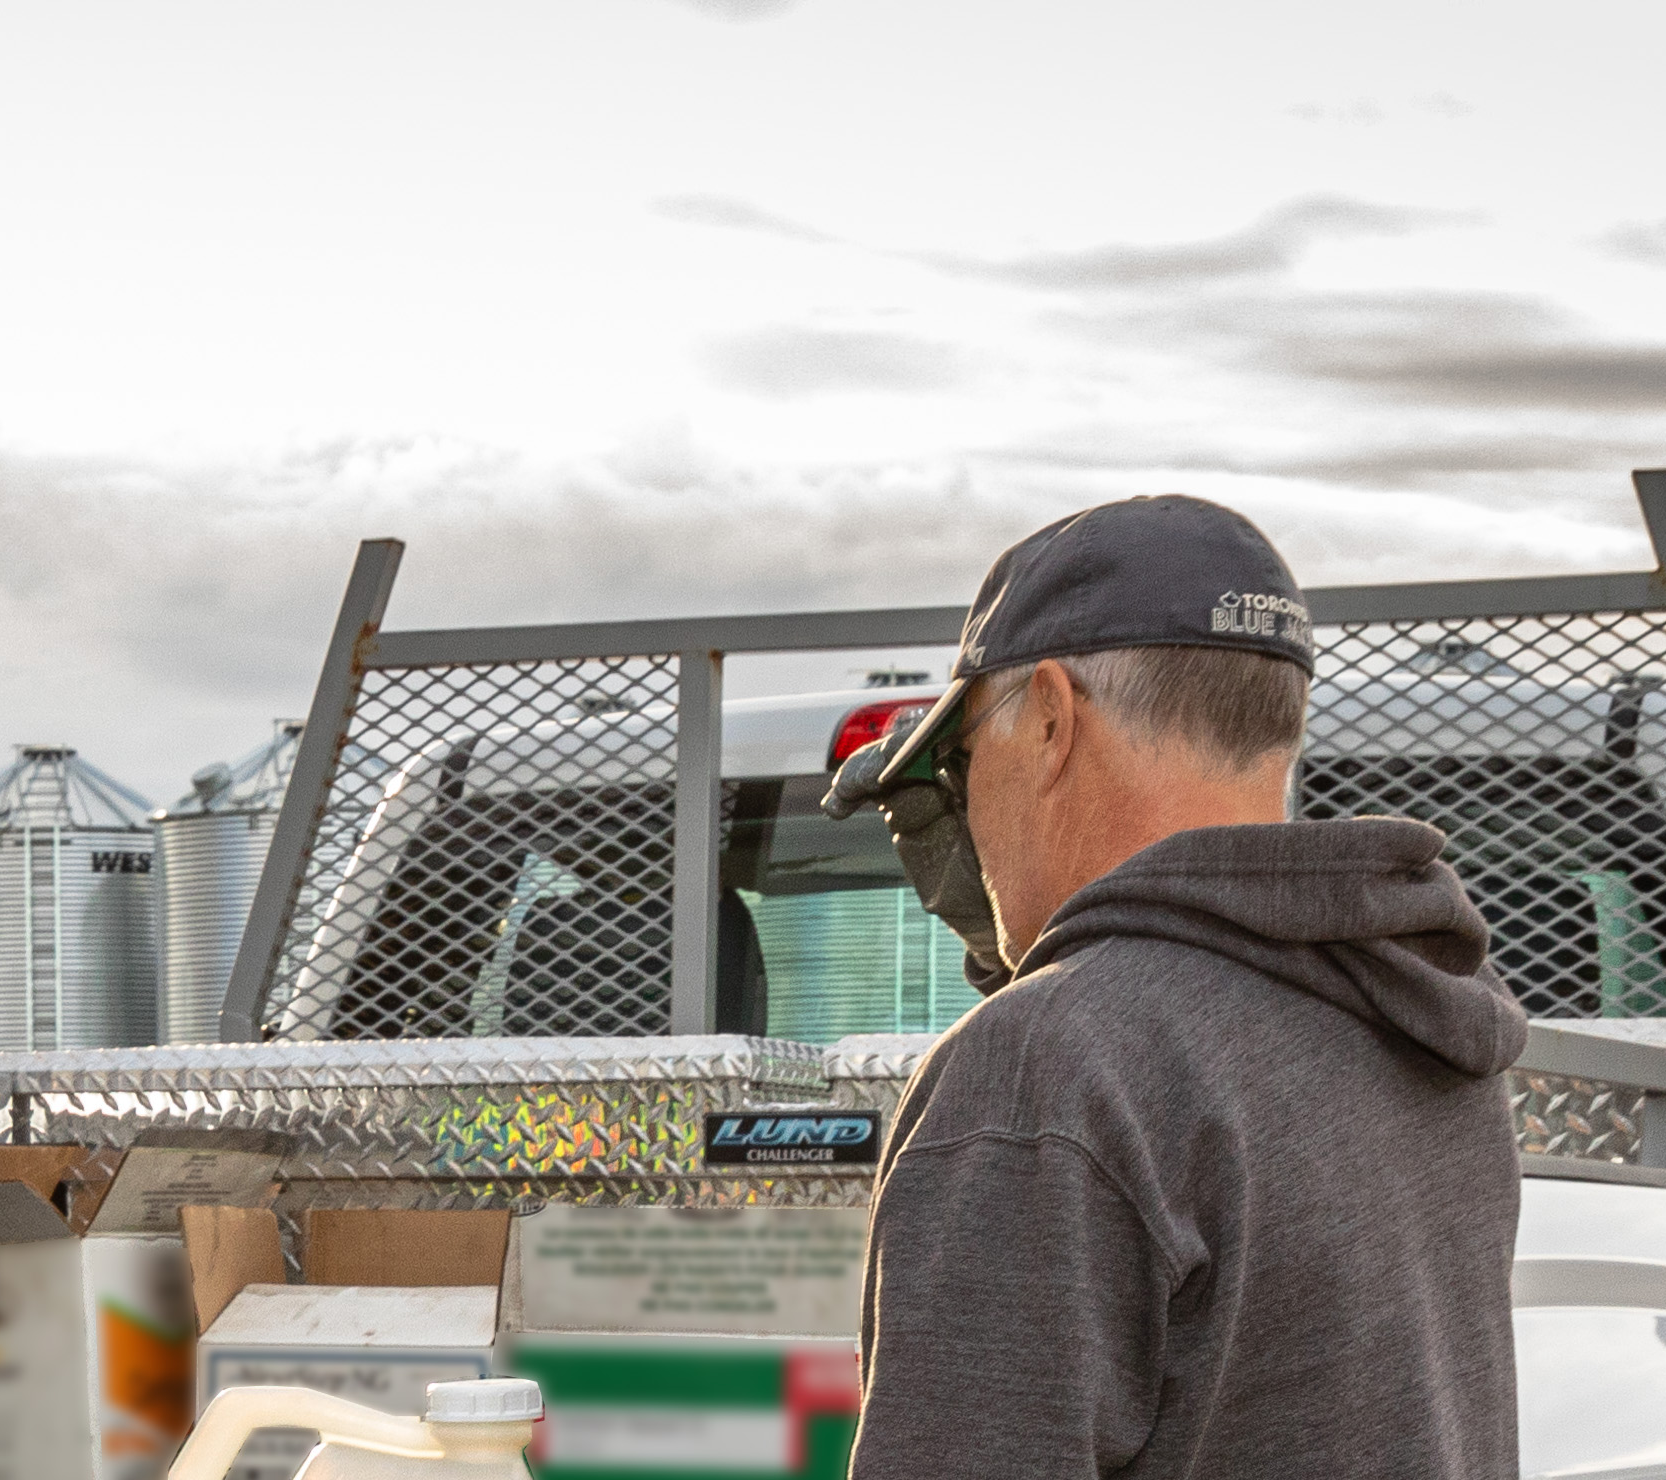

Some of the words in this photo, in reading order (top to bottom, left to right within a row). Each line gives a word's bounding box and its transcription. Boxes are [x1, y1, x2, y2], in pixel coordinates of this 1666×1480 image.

[1211, 607, 1277, 637] BLUE
[712, 1117, 873, 1147] LUND
[746, 1148, 834, 1162] CHALLENGER
